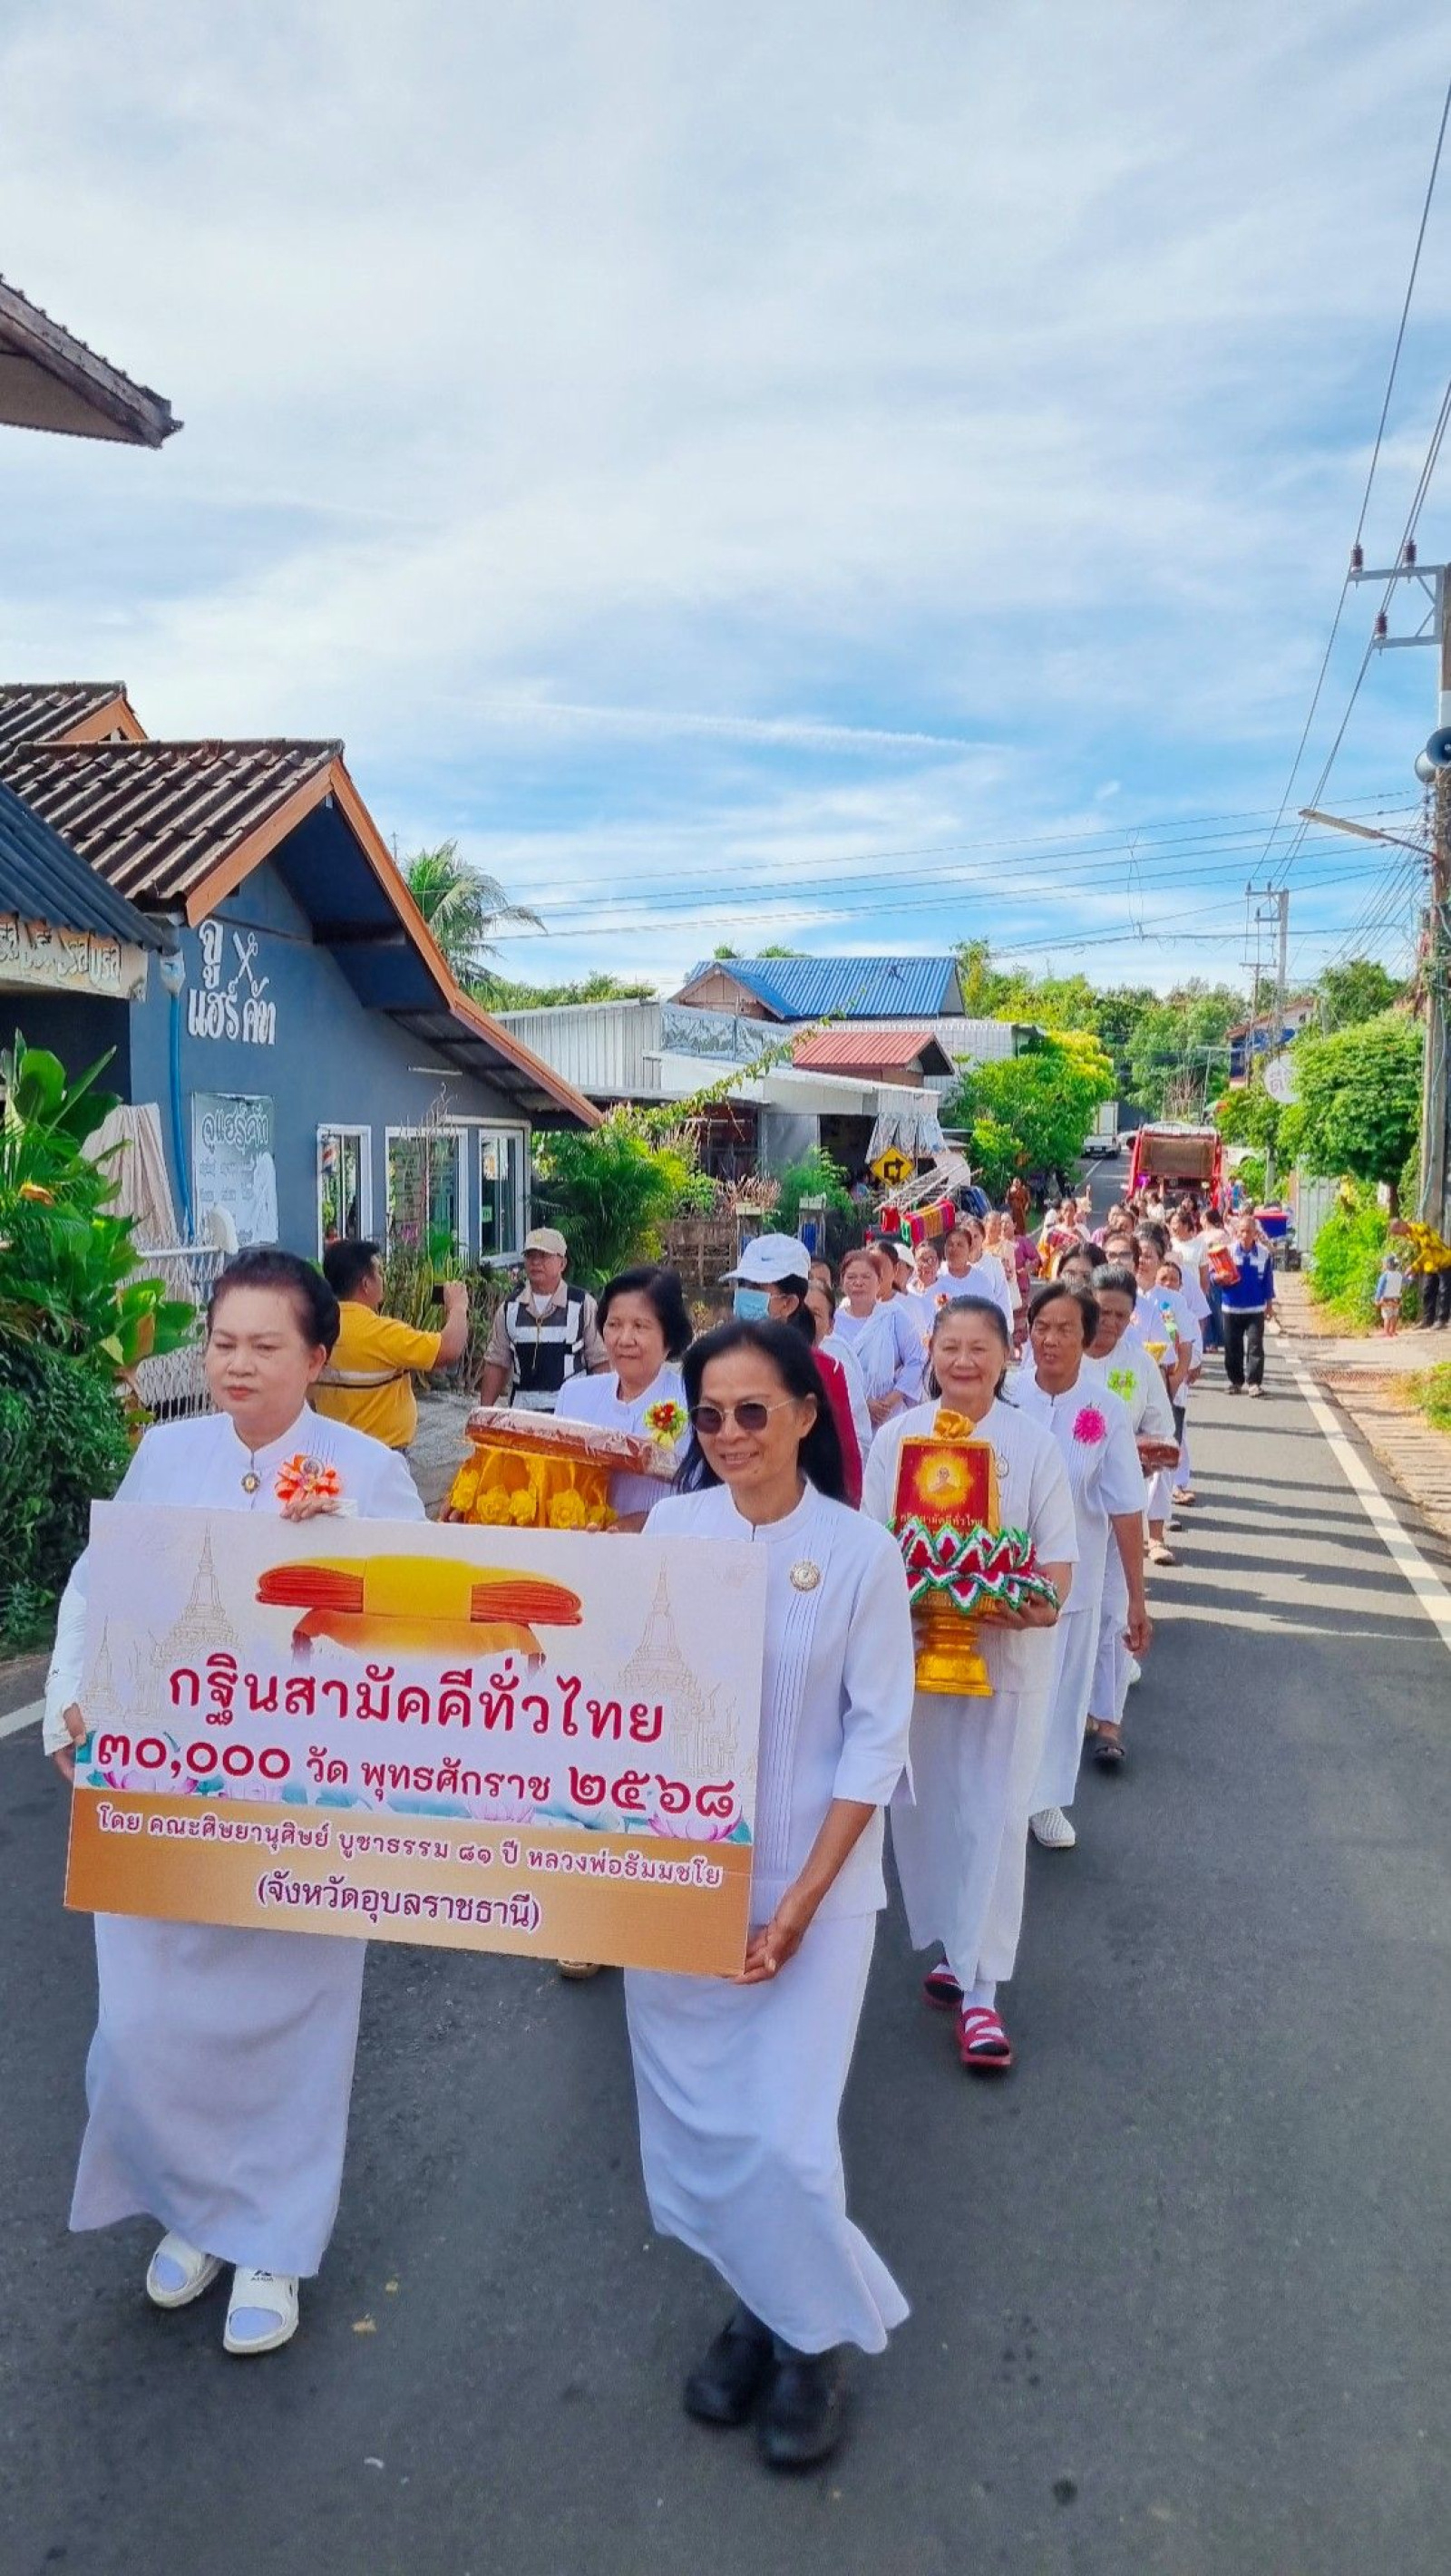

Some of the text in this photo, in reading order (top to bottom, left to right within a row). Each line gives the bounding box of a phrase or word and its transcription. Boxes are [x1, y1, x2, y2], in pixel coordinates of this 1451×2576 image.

[169, 1652, 664, 1743] กฐินสามัคคีทั่วไทย
[97, 1733, 735, 1819] ๓๐,๐๐๐ วัด พุทธศักราช ๒๕๖๘
[99, 1804, 721, 1885] โดย คณะศิษยานุศิษย์ บูชาธรรม ๘๑ ปี หลวงพ่อธัมมชโย
[257, 1870, 540, 1933] (จังหวัดอุบลราชธานี)
